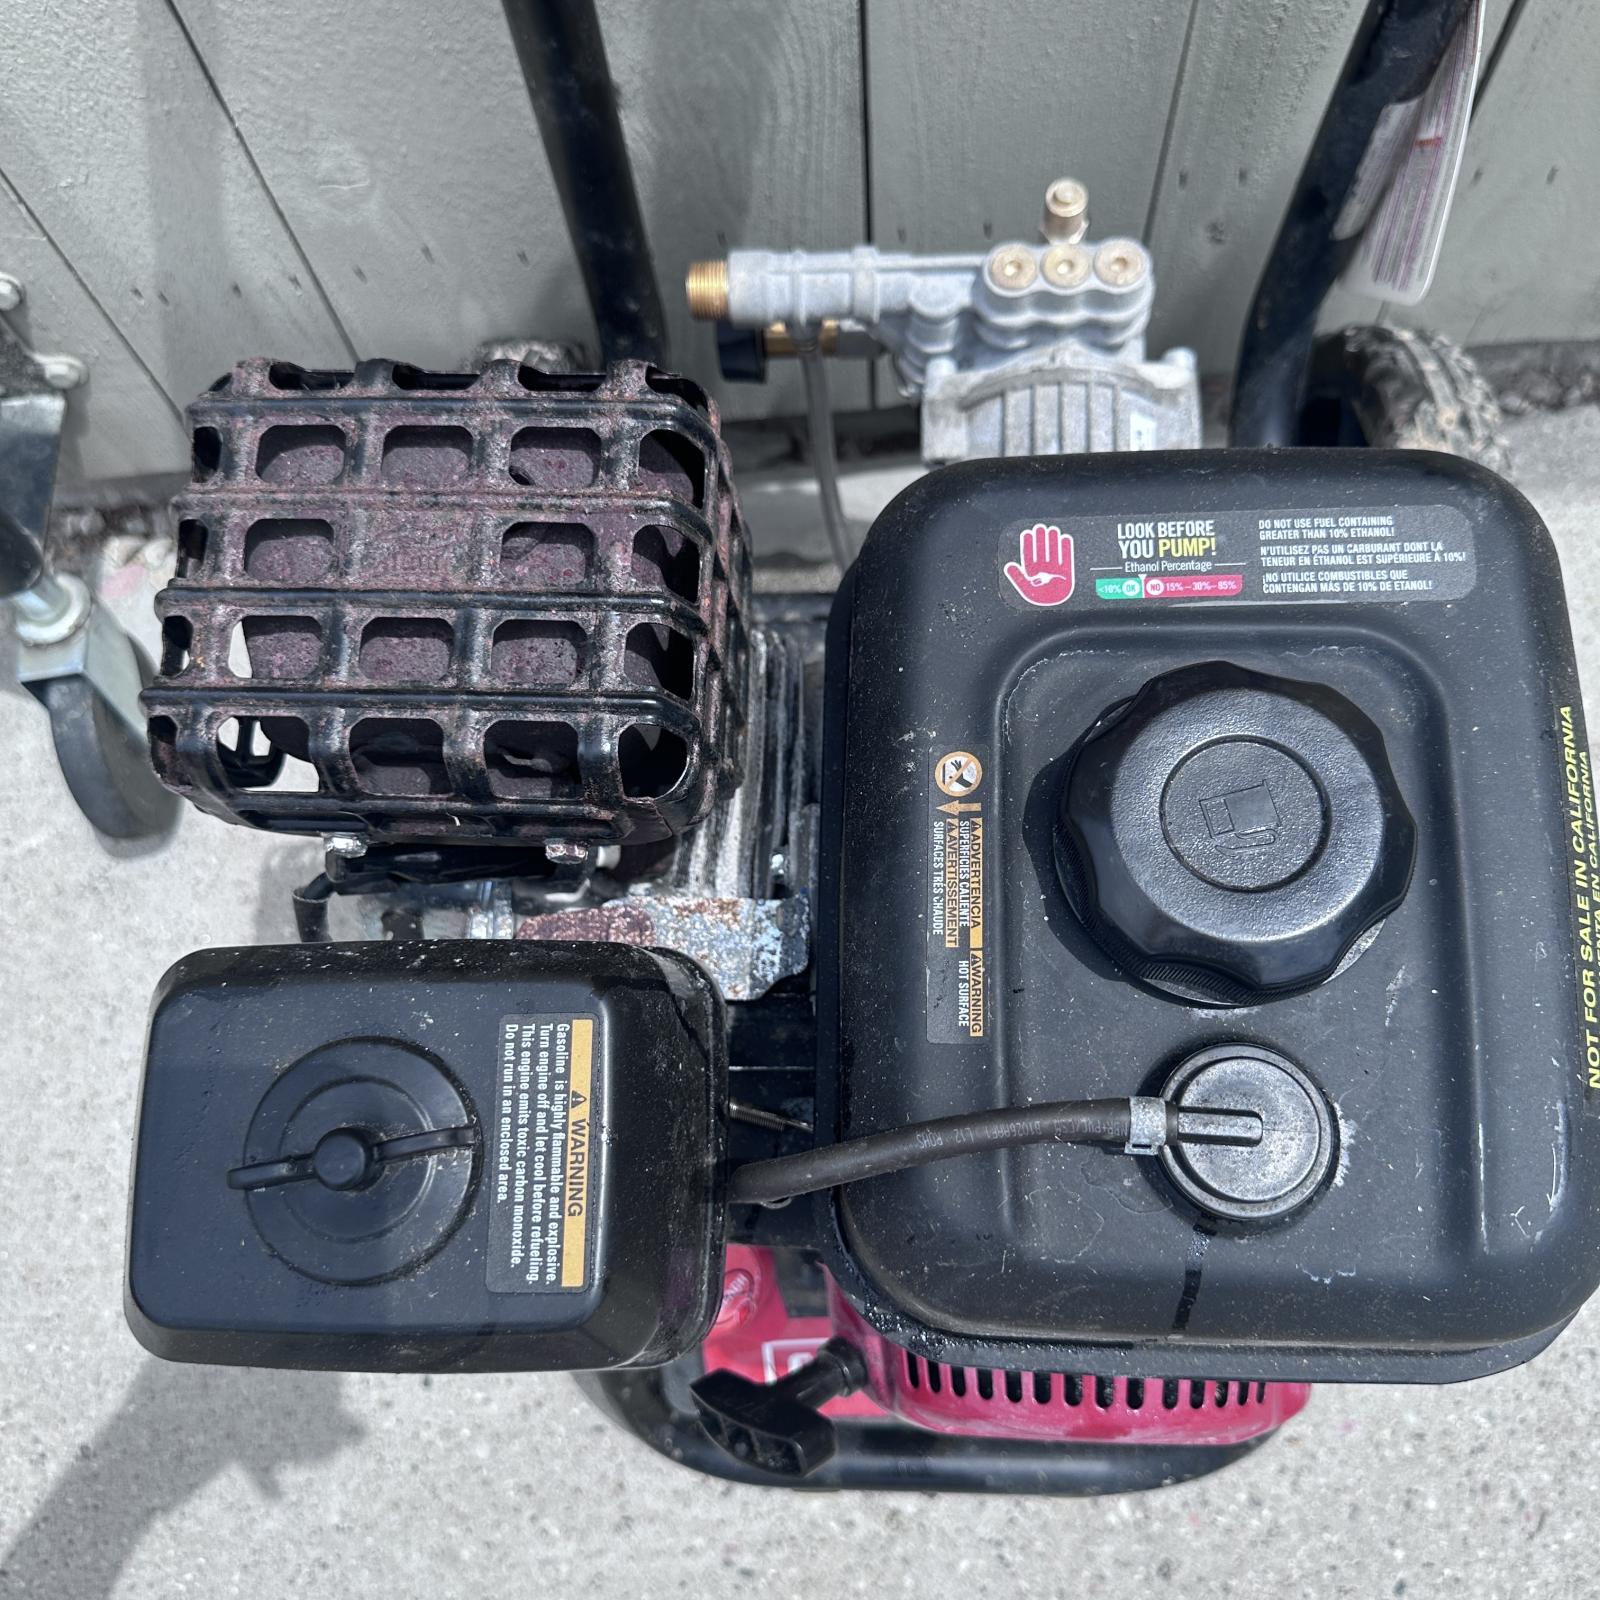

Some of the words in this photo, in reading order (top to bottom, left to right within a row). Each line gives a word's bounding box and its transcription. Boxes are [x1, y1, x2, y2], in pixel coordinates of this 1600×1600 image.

[1117, 522, 1155, 539] LOOK
[1157, 519, 1216, 538] BEFORE
[1258, 519, 1271, 529] DO
[1273, 518, 1292, 529] NOT
[1293, 518, 1312, 528] USE
[1313, 517, 1336, 528] FUEL
[1338, 515, 1393, 528] CONTAINING
[1259, 528, 1300, 540] GREATER
[1301, 528, 1326, 539] THAN
[1329, 527, 1348, 538] 10%
[1350, 526, 1395, 538] ETHANOL!
[1118, 539, 1154, 559] YOU
[1158, 536, 1217, 558] PUMP!
[1260, 545, 1310, 556] N'UTILISEZ
[1311, 544, 1329, 554] PAS
[1331, 544, 1344, 554] UN
[1346, 541, 1402, 554] CARBURANT
[1403, 541, 1428, 552] DONT
[1430, 541, 1443, 552] LA
[1260, 556, 1296, 567] TENEUR
[1298, 555, 1310, 566] EN
[1313, 553, 1354, 566] ÉTHANOL
[1356, 554, 1374, 565] EST
[1375, 552, 1432, 564] SUPÉRIEURE
[1443, 551, 1466, 562] 10%!
[1124, 561, 1159, 573] Ethanol
[1161, 560, 1213, 573] Percentage
[1262, 572, 1278, 585] ¡NO
[1280, 571, 1316, 582] UTILICE
[1317, 569, 1388, 582] COMBUSTIBLES
[1389, 569, 1409, 580] QUE
[1262, 582, 1318, 594] CONTENGAN
[1319, 580, 1341, 593] MÁS
[1342, 582, 1355, 592] DE
[1356, 581, 1378, 592] 10%
[1379, 580, 1392, 592] DE
[1394, 579, 1433, 591] ETANOL!
[1559, 705, 1586, 854] CALIFORNIA
[1579, 751, 1599, 869] CALIFORNIA
[932, 820, 944, 869] SURFACES
[959, 820, 970, 880] SUPERFICIES
[970, 834, 982, 929] ADVERTENCIA
[1574, 859, 1588, 888] IN
[1591, 872, 1600, 902] EN
[946, 834, 958, 946] AVERTISSEMENT
[959, 881, 970, 927] CALIENTE
[932, 896, 944, 935] CHAUDE
[1576, 893, 1593, 963] SALE
[958, 960, 970, 980] HOT
[958, 982, 970, 1027] SURFACE
[971, 964, 982, 1033] WARNING
[1582, 968, 1598, 1023] FOR
[505, 1023, 519, 1040] Do
[521, 1023, 536, 1048] This
[540, 1023, 554, 1048] Turn
[503, 1042, 516, 1061] not
[555, 1023, 570, 1074] Gasoline
[1585, 1028, 1600, 1089] NOT
[502, 1063, 514, 1083] run
[517, 1050, 534, 1090] engine
[535, 1050, 552, 1090] engine
[554, 1080, 568, 1091] is
[501, 1099, 513, 1114] an
[502, 1085, 516, 1097] in
[537, 1093, 551, 1110] off
[517, 1093, 532, 1125] emits
[535, 1112, 549, 1133] and
[550, 1093, 568, 1130] highly
[498, 1116, 514, 1171] enclosed
[516, 1127, 530, 1158] toxic
[534, 1136, 549, 1153] let
[533, 1154, 547, 1181] cool
[550, 1132, 566, 1194] flammable
[567, 1118, 586, 1217] WARNING
[496, 1173, 509, 1204] area.
[514, 1160, 529, 1202] carbon
[531, 1184, 547, 1222] before
[548, 1196, 562, 1219] and
[510, 1205, 526, 1268] monoxide.
[526, 1225, 544, 1285] refueling.
[545, 1221, 561, 1285] explosive.
